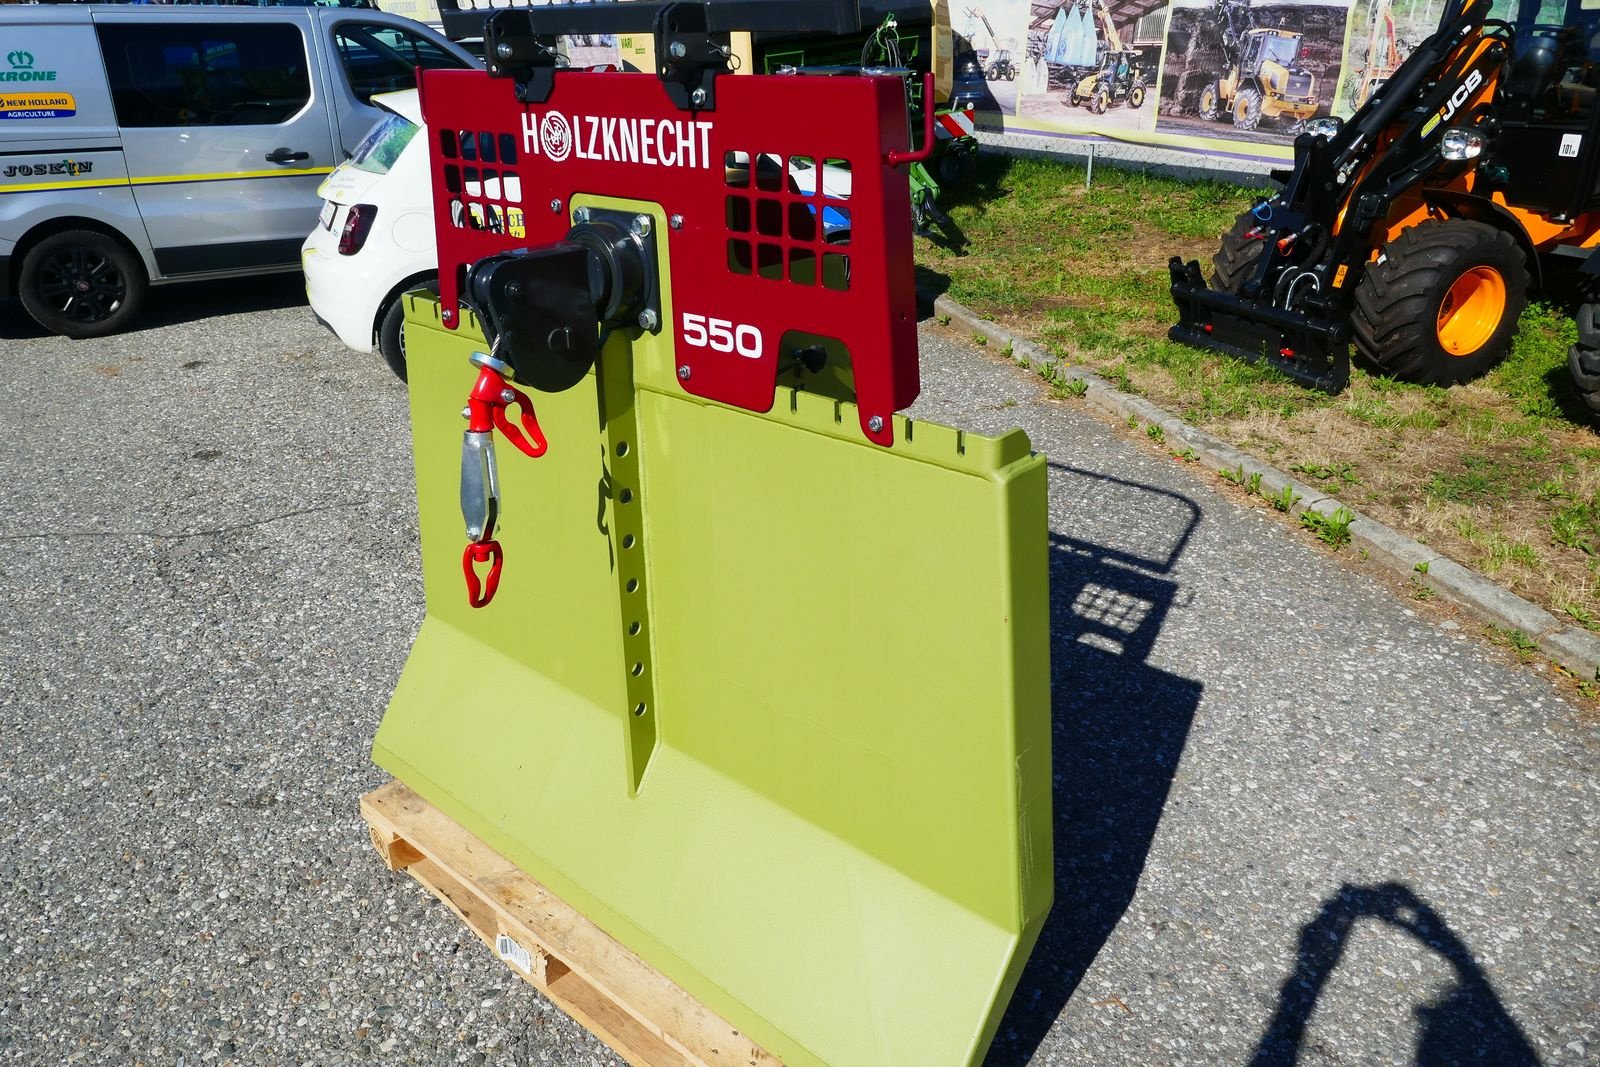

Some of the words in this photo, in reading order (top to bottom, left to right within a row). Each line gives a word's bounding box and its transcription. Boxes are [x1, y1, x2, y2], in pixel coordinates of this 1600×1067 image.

[28, 98, 68, 106] HOLLAND
[1443, 69, 1482, 121] JCB
[7, 110, 56, 118] AGRICULTURE
[521, 110, 713, 169] HOLZKNECHT
[3, 160, 93, 177] JOSKIN
[683, 312, 762, 359] 550
